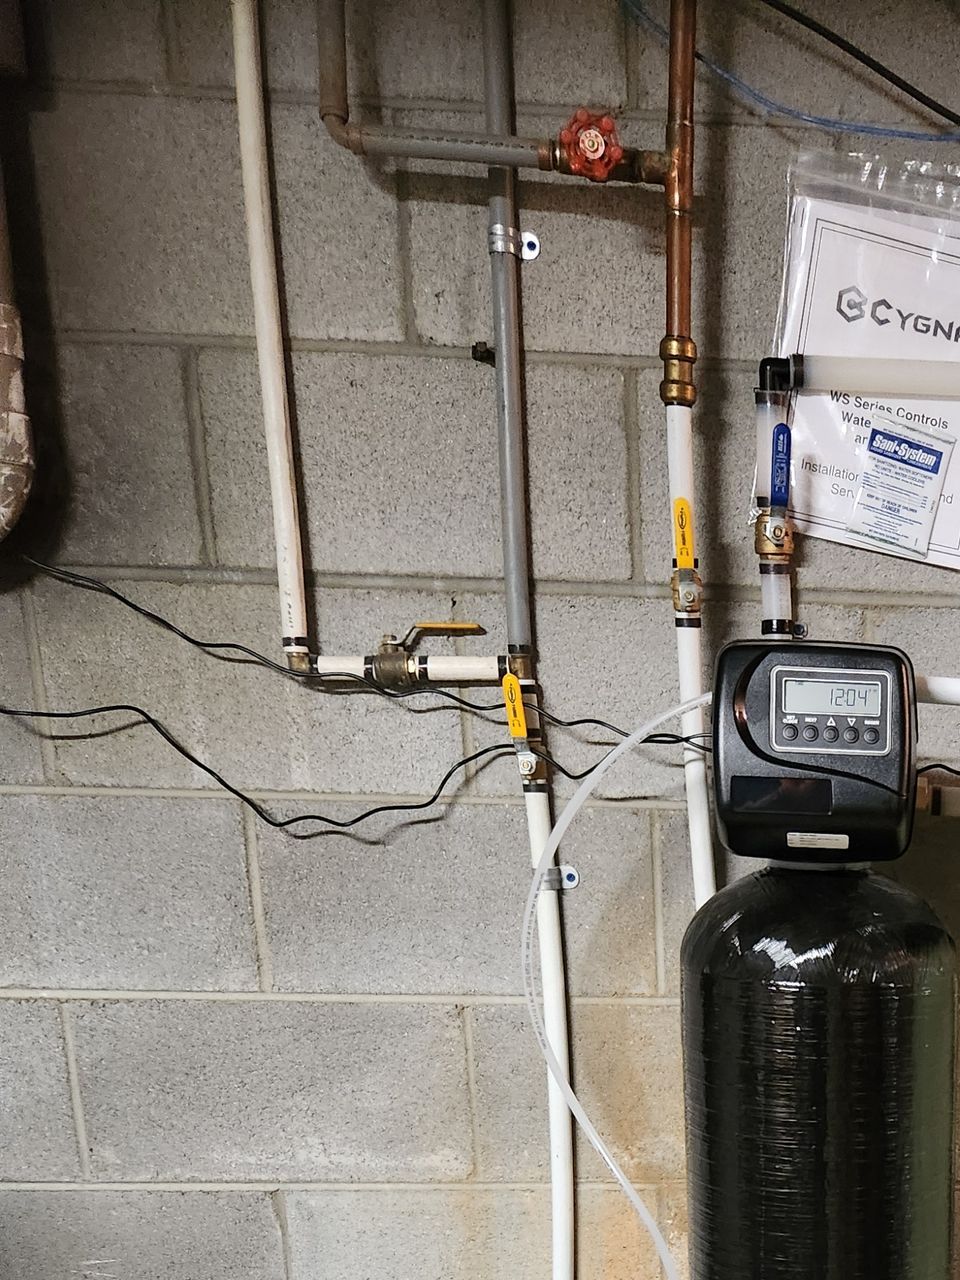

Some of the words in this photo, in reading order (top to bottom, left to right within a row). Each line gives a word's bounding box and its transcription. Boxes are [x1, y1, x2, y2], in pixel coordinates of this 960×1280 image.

[830, 390, 851, 405] WS
[896, 407, 949, 430] Controls
[830, 688, 868, 707] 12:04
